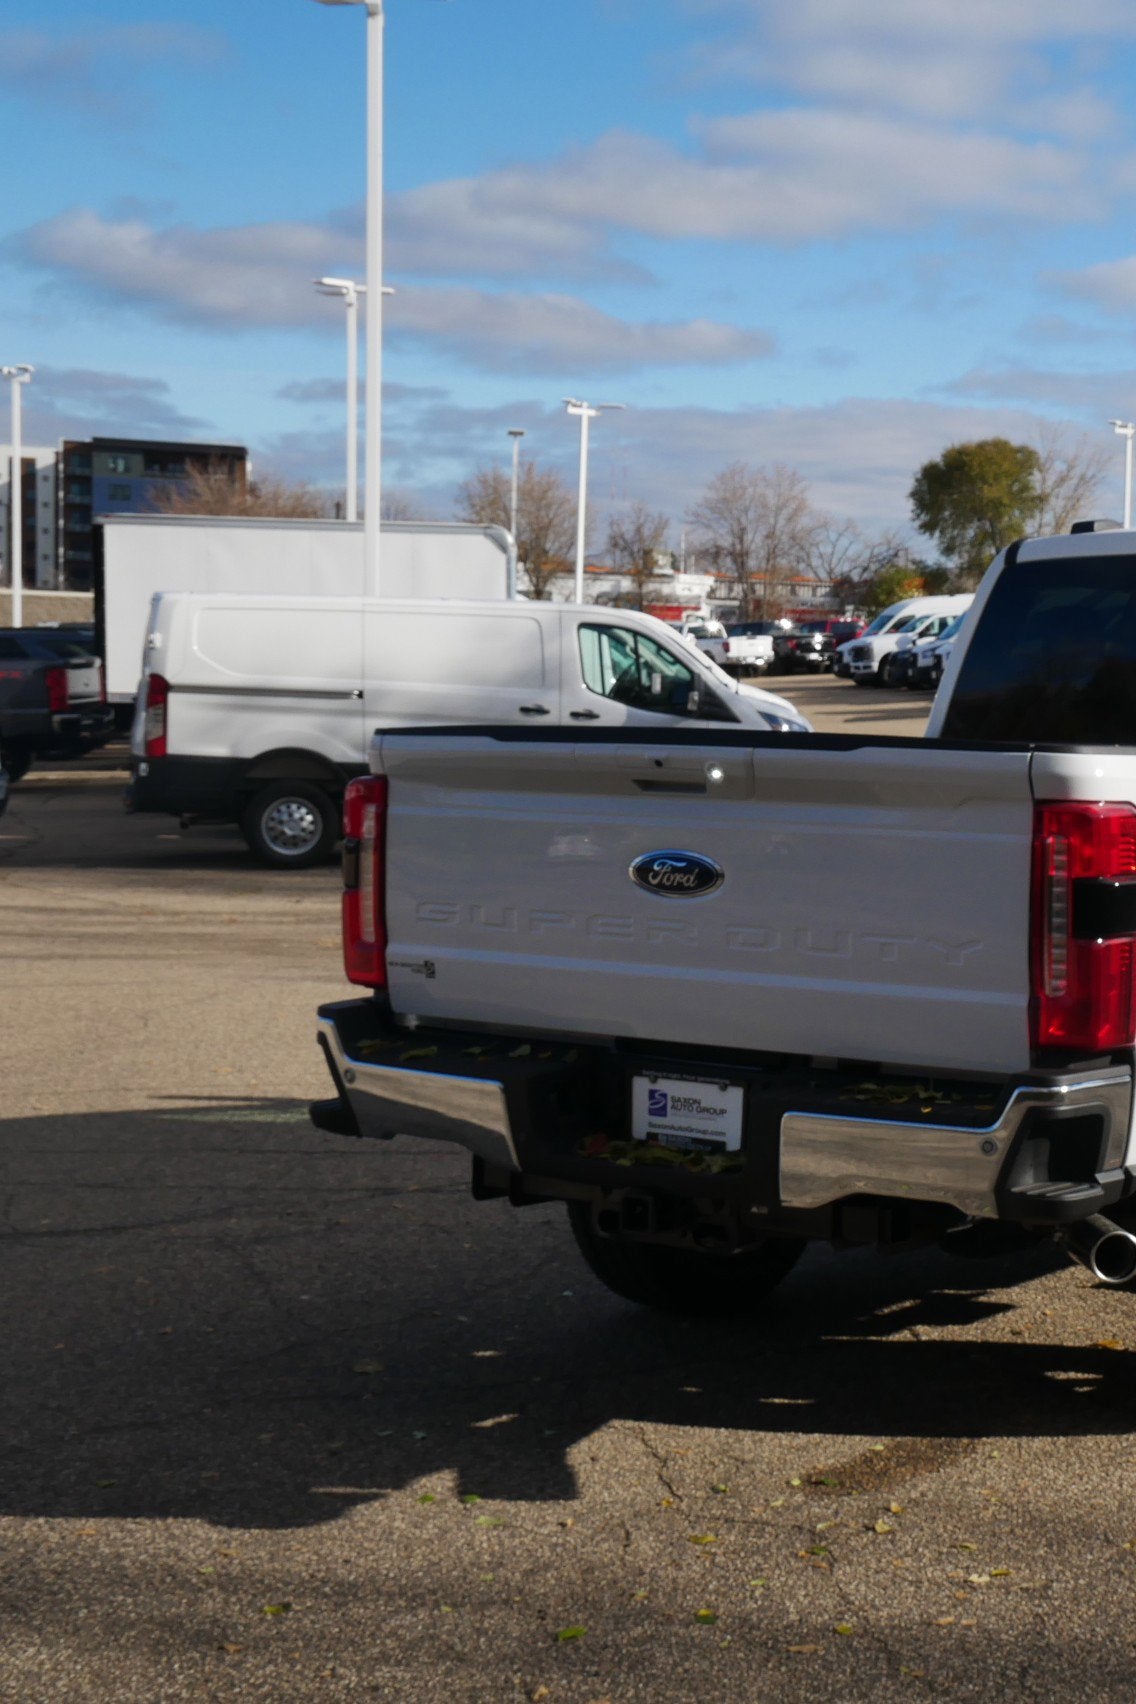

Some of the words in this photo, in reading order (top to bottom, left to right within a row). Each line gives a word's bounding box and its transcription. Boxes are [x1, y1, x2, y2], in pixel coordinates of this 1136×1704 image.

[648, 859, 699, 886] Ford
[415, 899, 698, 946] SUPER
[726, 923, 985, 967] DUTY
[670, 1095, 701, 1106] SAXON
[670, 1104, 694, 1113] AUTO
[695, 1106, 728, 1116] GROUP
